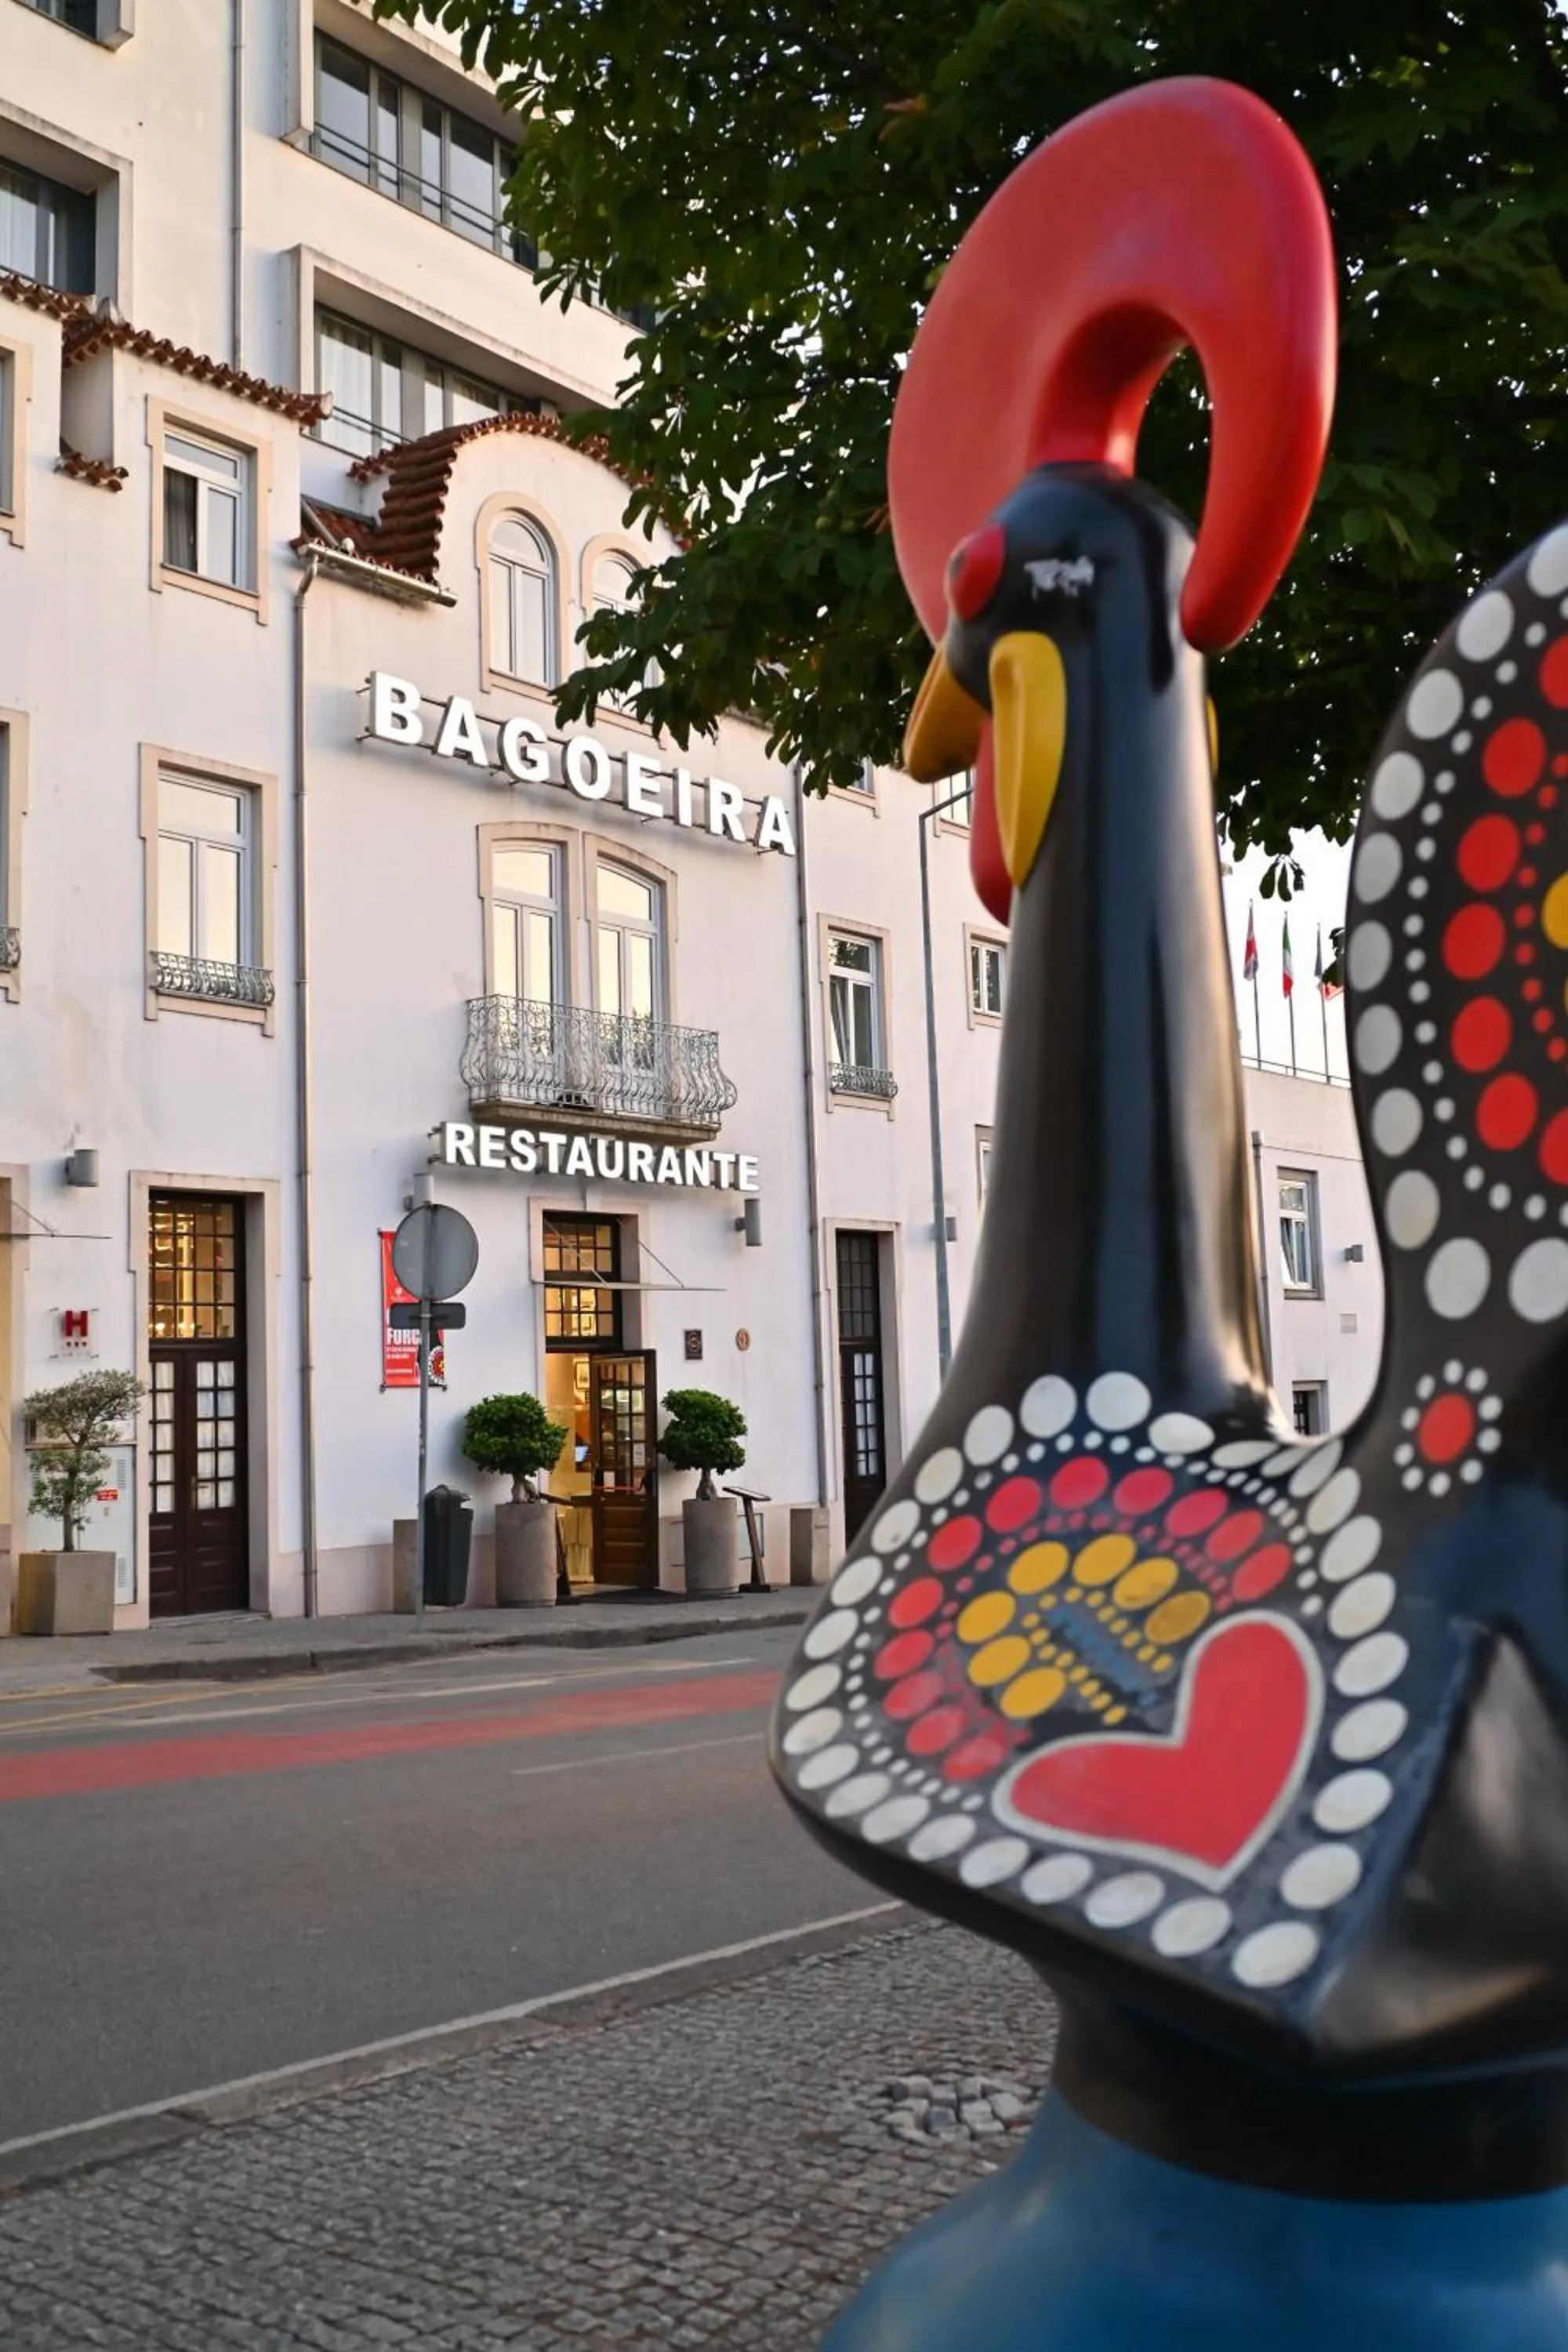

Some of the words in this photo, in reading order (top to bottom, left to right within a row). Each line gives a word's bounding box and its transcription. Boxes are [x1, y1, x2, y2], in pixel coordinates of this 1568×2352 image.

[371, 671, 796, 856] BAGOEIRA
[444, 1121, 760, 1192] RESTAURANTE
[65, 1310, 89, 1337] H
